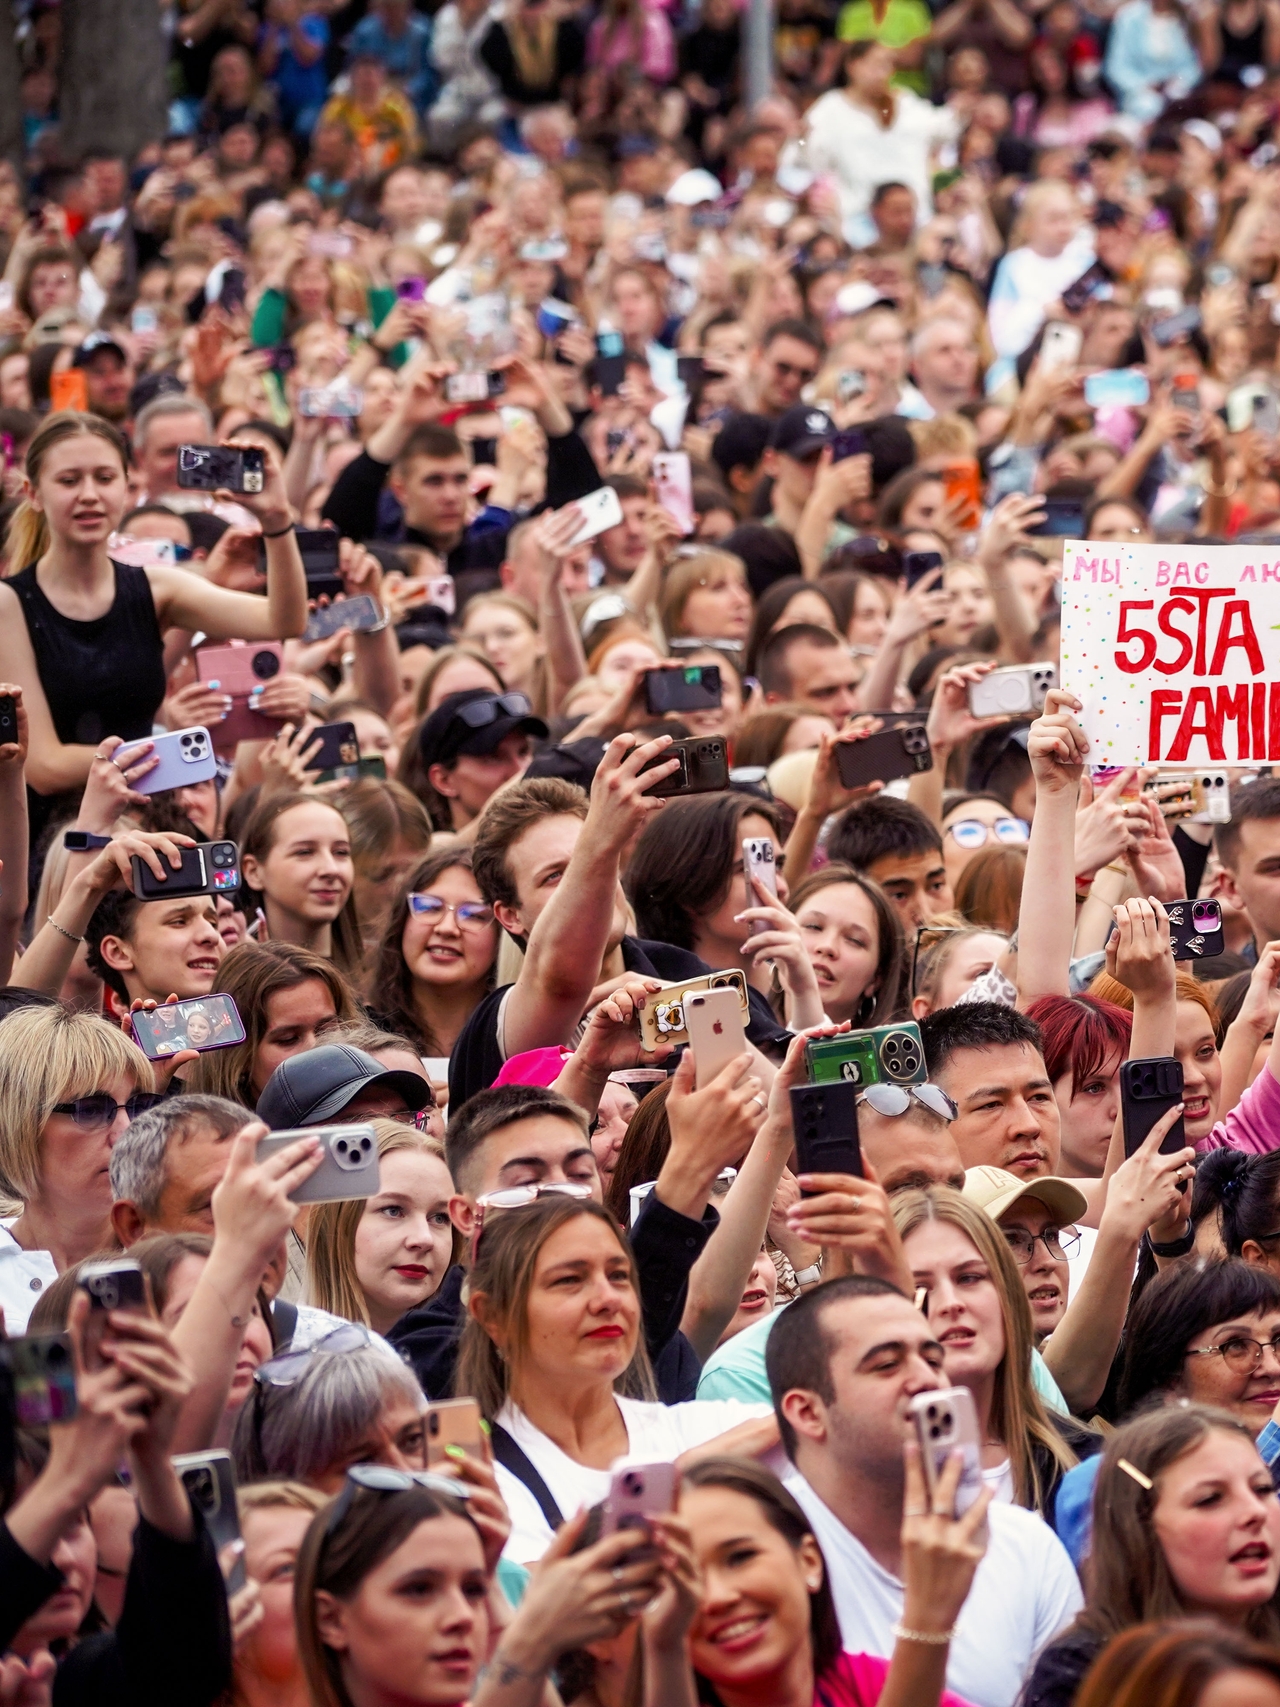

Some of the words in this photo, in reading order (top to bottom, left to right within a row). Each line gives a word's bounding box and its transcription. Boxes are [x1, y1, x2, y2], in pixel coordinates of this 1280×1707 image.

[1073, 556, 1121, 585] МЫ
[1155, 560, 1210, 587] ВАС
[1114, 586, 1265, 676] 5STA
